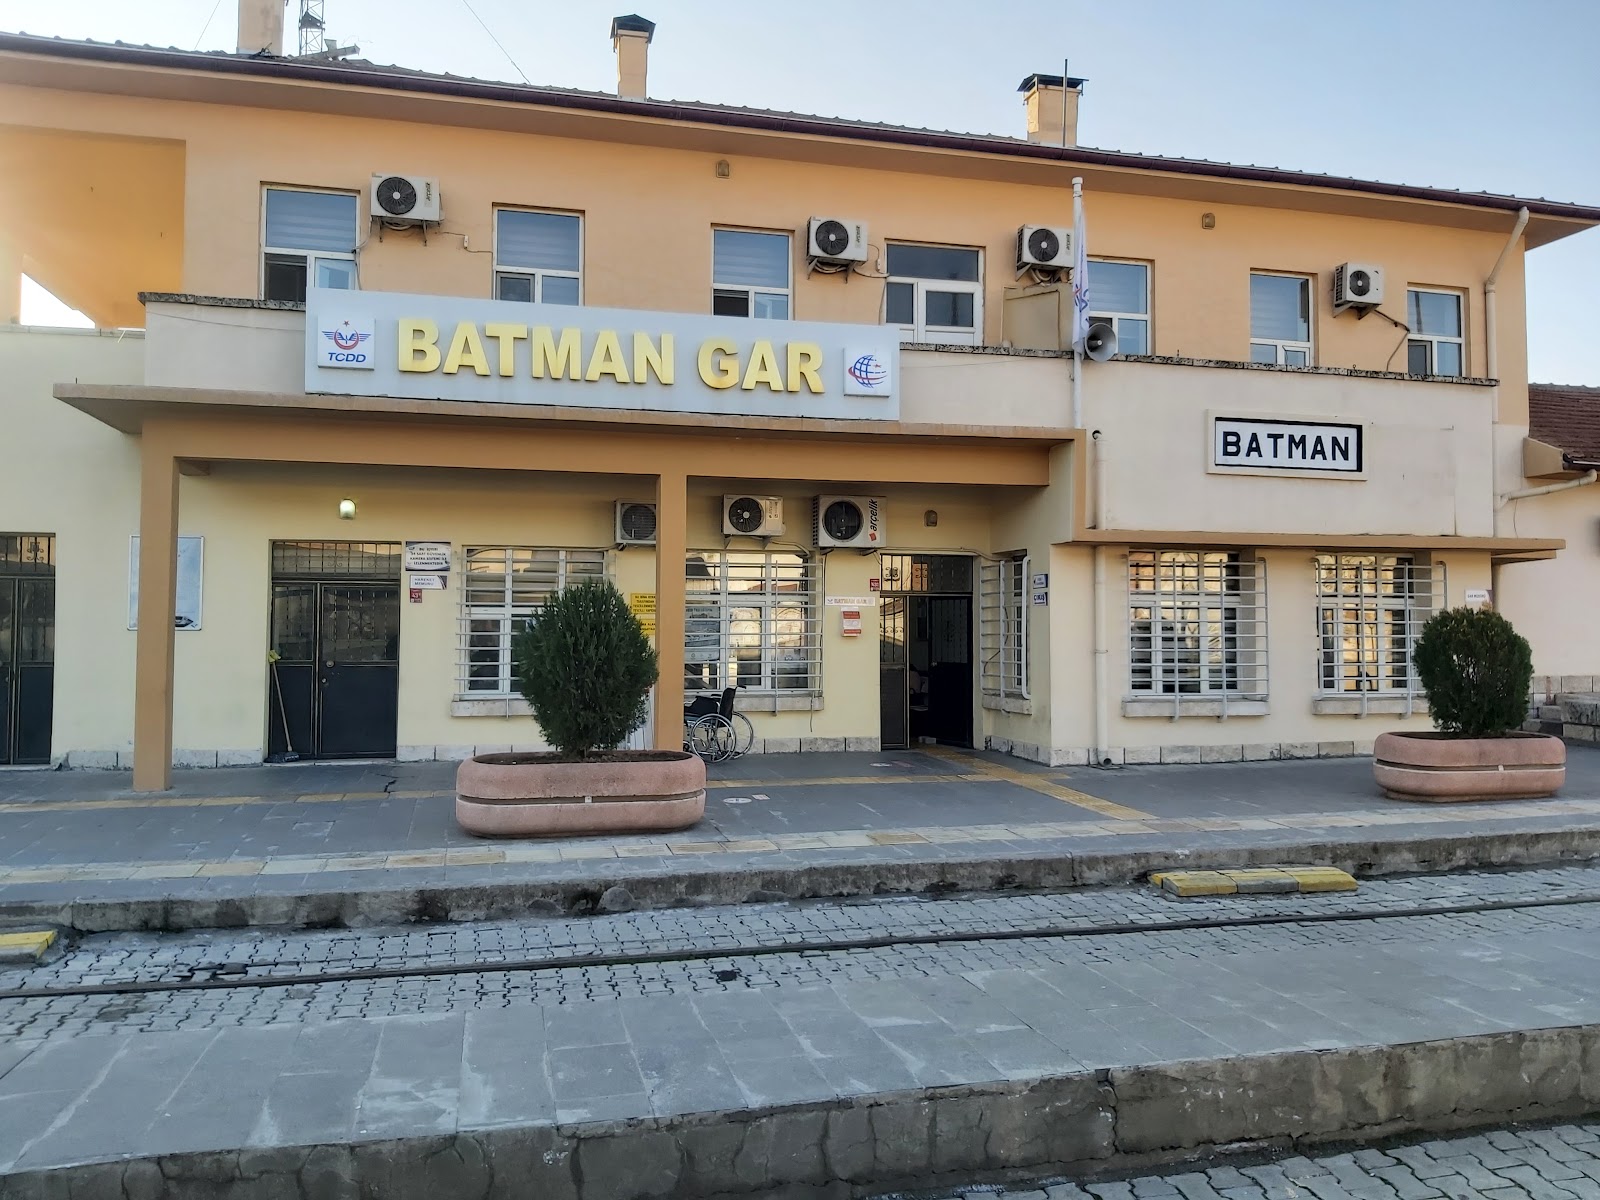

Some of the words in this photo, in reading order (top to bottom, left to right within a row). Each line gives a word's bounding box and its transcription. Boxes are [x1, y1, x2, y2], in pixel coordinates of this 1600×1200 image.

[327, 352, 366, 363] TCDD
[397, 318, 675, 385] BATMAN
[697, 336, 826, 394] GAR
[1222, 431, 1349, 461] BATMAN
[868, 498, 878, 532] arçelik
